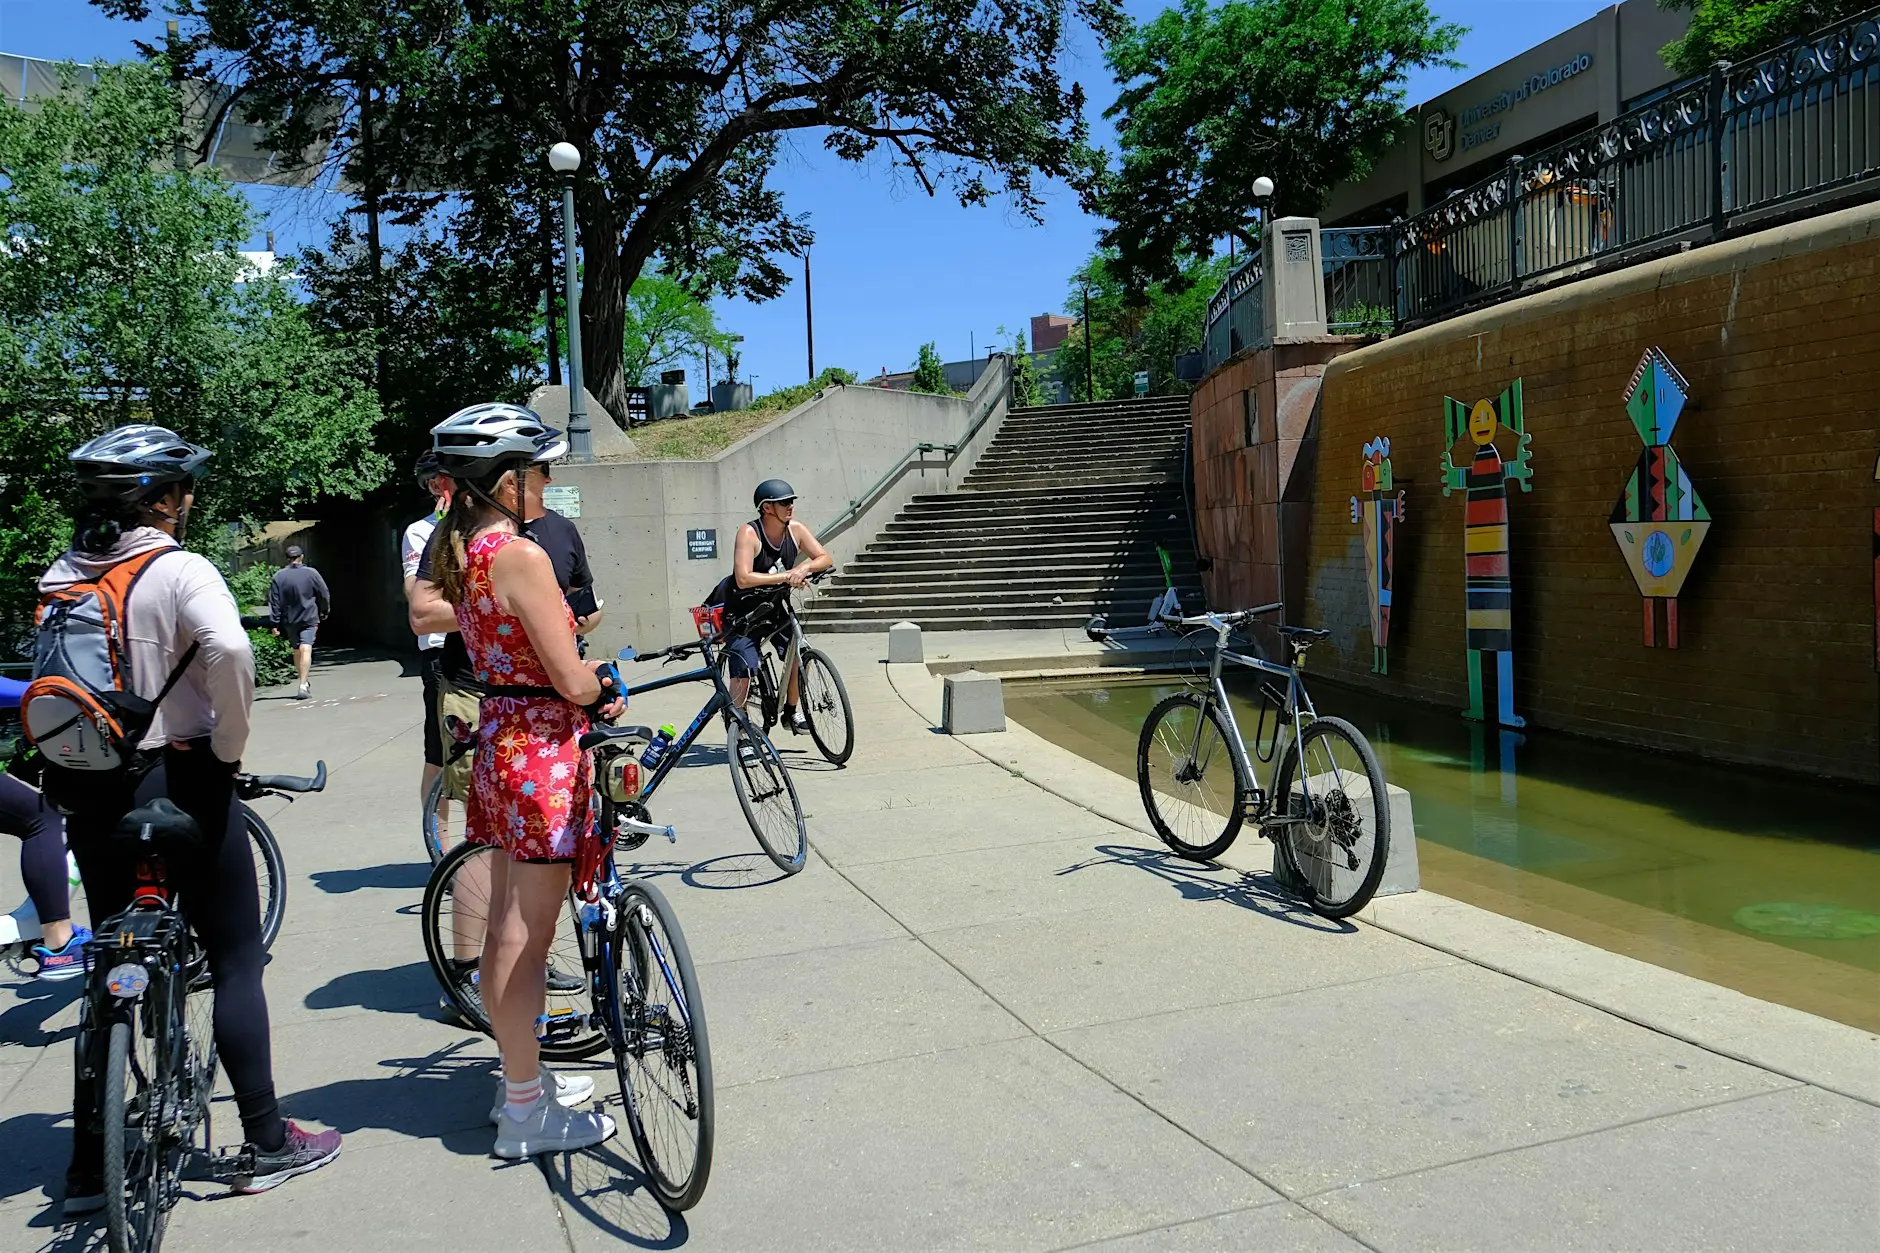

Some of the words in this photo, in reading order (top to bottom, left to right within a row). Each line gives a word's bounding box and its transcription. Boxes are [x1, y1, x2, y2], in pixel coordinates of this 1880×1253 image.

[1461, 92, 1515, 127] University
[1515, 83, 1529, 102] of
[1529, 54, 1591, 94] Colorado
[1461, 124, 1500, 151] Denver
[696, 531, 706, 540] NO
